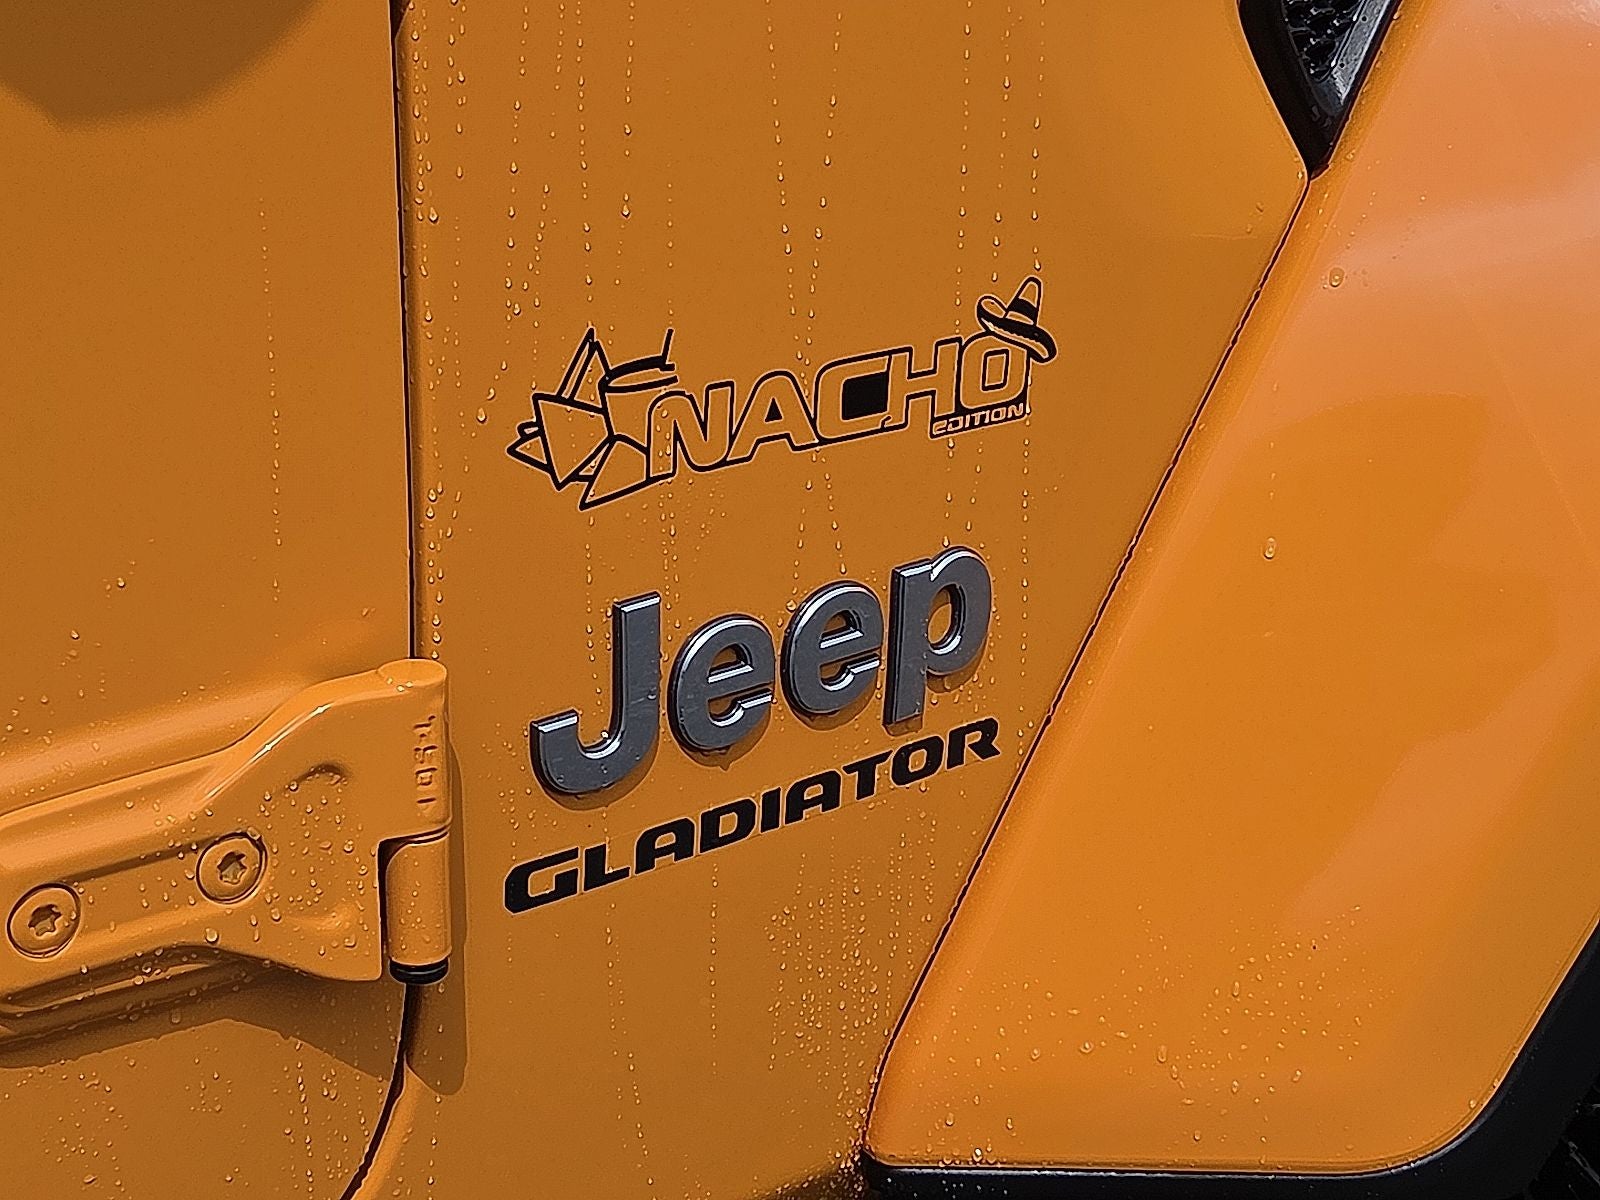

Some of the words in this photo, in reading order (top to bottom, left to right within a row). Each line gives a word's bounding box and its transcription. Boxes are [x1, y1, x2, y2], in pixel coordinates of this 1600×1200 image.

[646, 329, 1031, 481] NACHO
[931, 402, 1025, 436] EDITION
[530, 545, 992, 794] Jeep
[503, 717, 1001, 914] GLADIATOR
